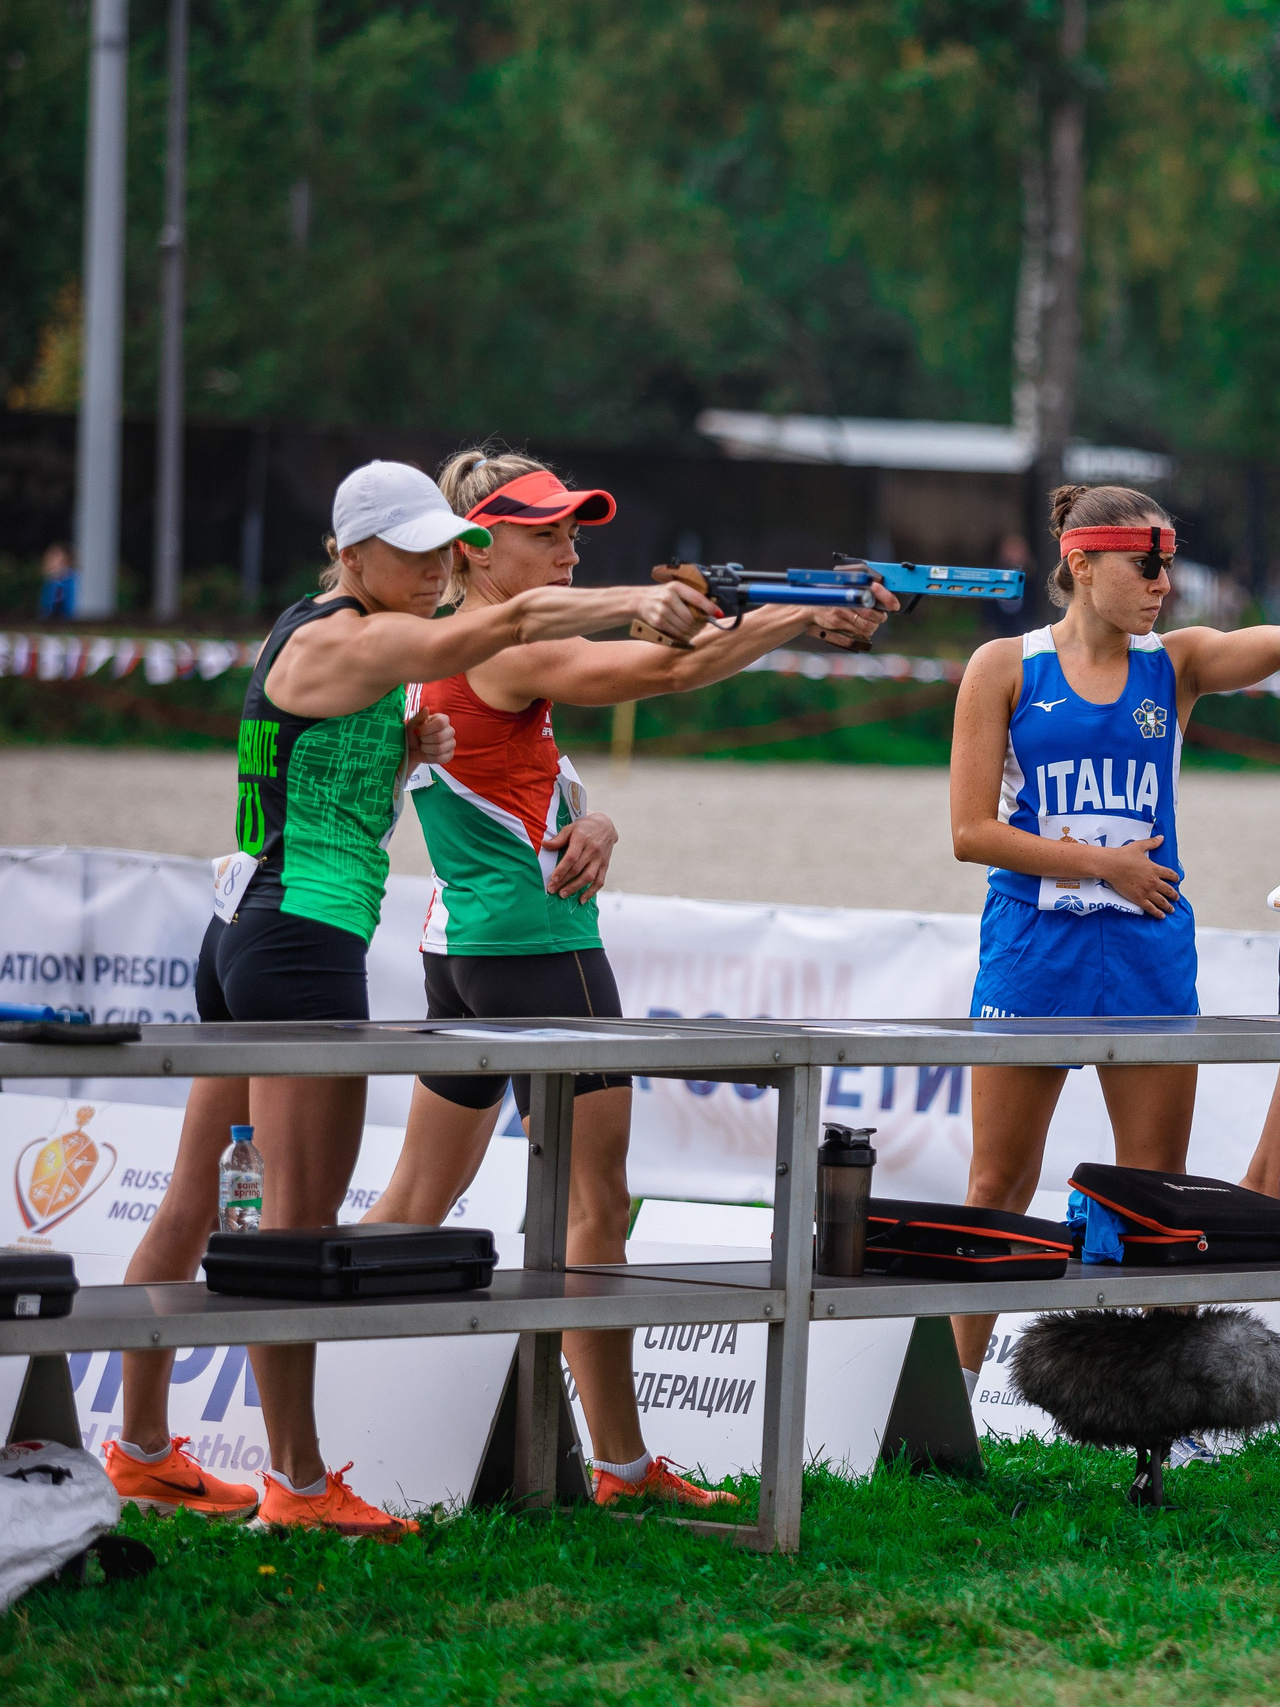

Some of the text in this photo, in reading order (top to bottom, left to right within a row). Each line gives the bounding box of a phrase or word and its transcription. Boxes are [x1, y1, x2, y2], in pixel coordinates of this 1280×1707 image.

[1036, 758, 1159, 817] ITALIA
[224, 861, 242, 896] 8
[0, 954, 200, 989] ATION PRESID
[234, 1188, 261, 1199] spring
[237, 1181, 259, 1190] saint
